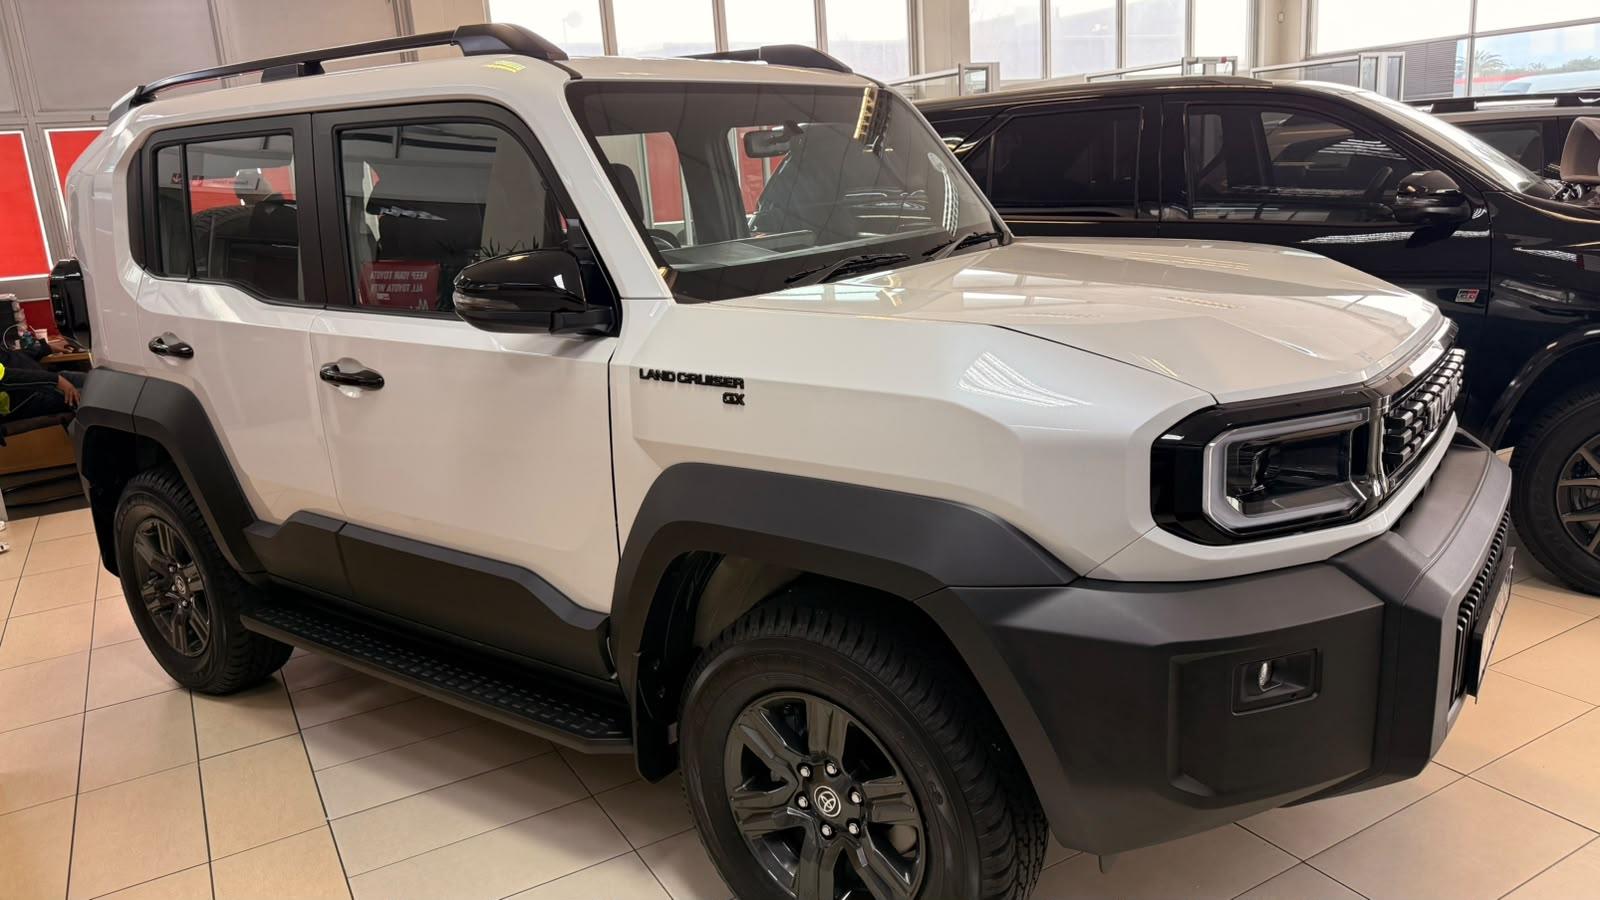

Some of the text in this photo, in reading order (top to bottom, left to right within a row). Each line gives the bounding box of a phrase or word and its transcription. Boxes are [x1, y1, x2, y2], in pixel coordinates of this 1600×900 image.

[639, 368, 745, 389] LAND CRUISER
[722, 392, 745, 406] GX
